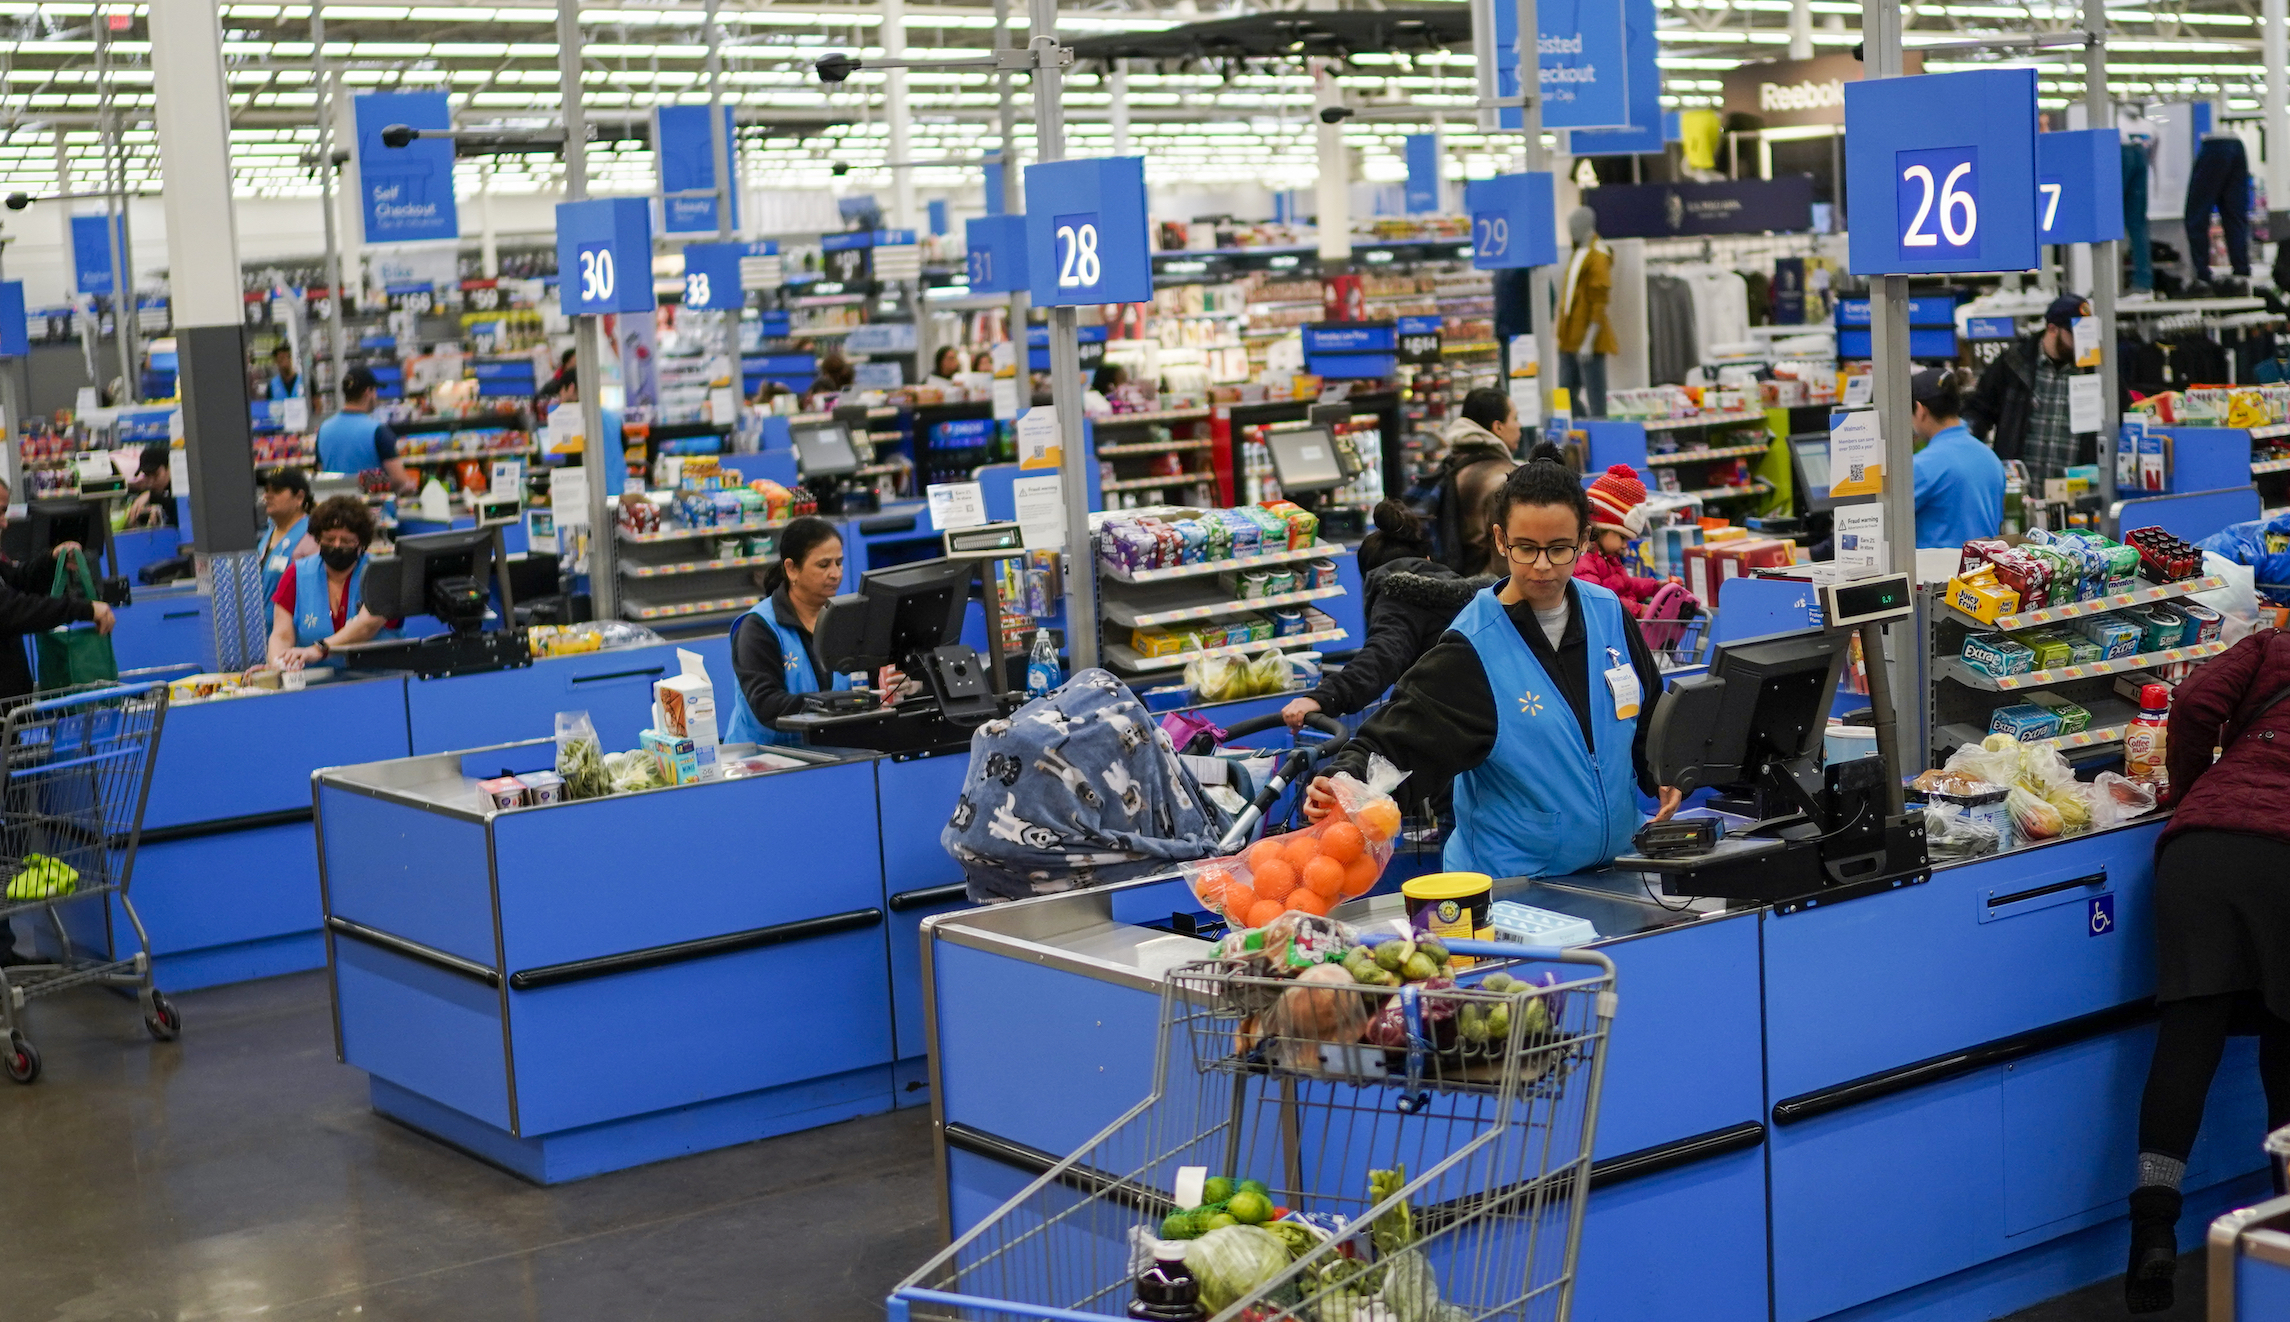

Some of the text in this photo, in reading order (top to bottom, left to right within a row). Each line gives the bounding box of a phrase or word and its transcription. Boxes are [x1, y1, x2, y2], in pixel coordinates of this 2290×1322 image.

[1514, 62, 1597, 83] Ceckout
[373, 185, 400, 201] Self
[375, 202, 436, 218] Checkout
[1903, 161, 1978, 247] 26
[2040, 183, 2063, 232] 7
[1478, 218, 1509, 258] 29
[1057, 223, 1101, 287] 28
[580, 248, 614, 300] 30
[972, 251, 993, 284] 31
[686, 272, 711, 307] 33
[2108, 579, 2135, 588] mentos
[1958, 598, 1978, 613] Fruit
[1964, 645, 1994, 662] Extra
[2108, 640, 2136, 659] Extra
[1993, 720, 2016, 734] Extra
[2021, 725, 2048, 742] Extra
